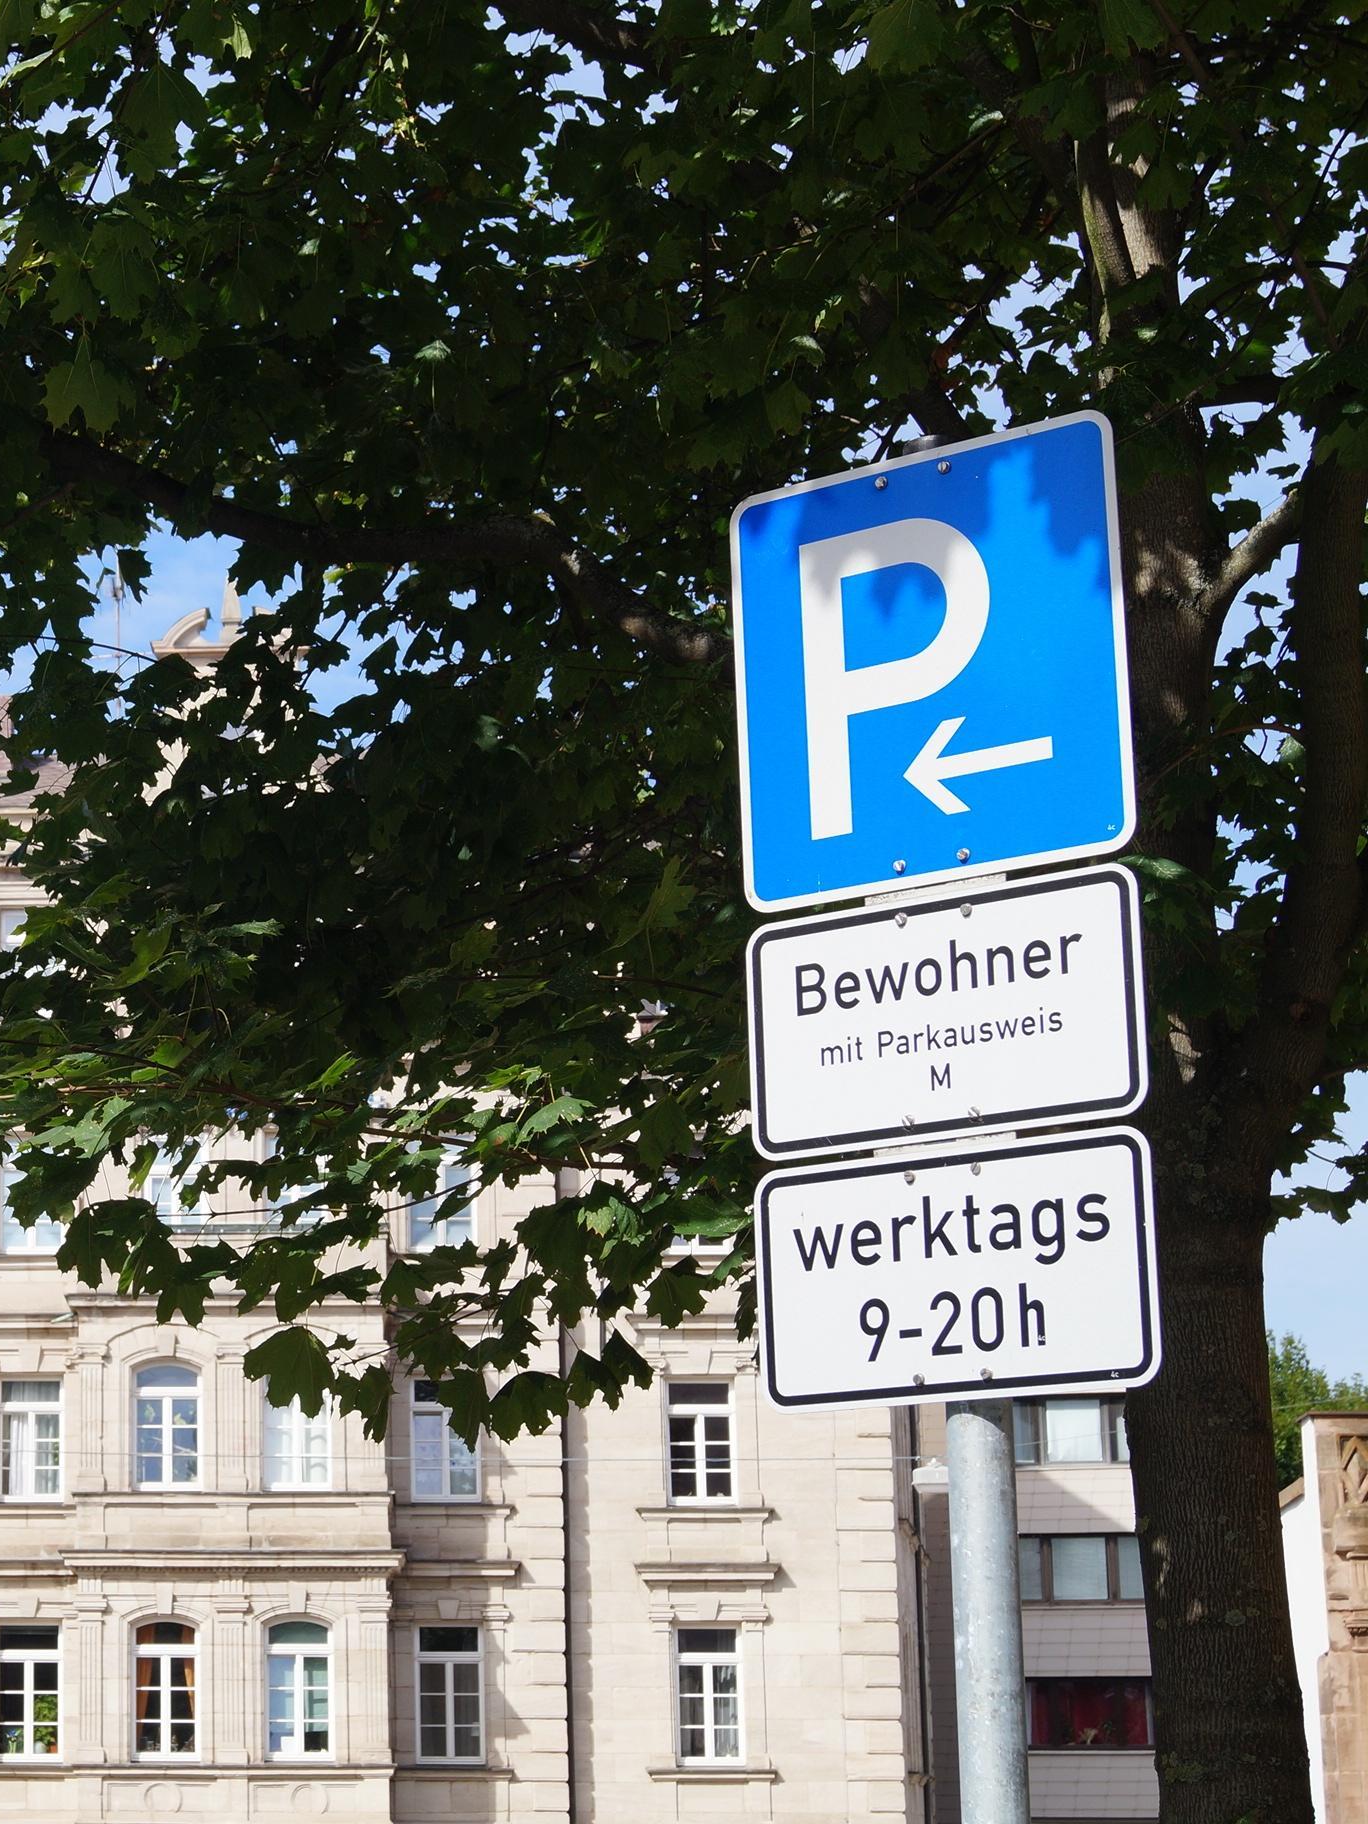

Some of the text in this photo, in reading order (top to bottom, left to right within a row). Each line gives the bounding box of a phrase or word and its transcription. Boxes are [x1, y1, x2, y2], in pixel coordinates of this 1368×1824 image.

[798, 517, 991, 841] P
[795, 932, 1083, 1017] Bewohner
[820, 1006, 1063, 1067] mit Parkausweis
[930, 1062, 952, 1091] M
[792, 1193, 1111, 1272] werktags
